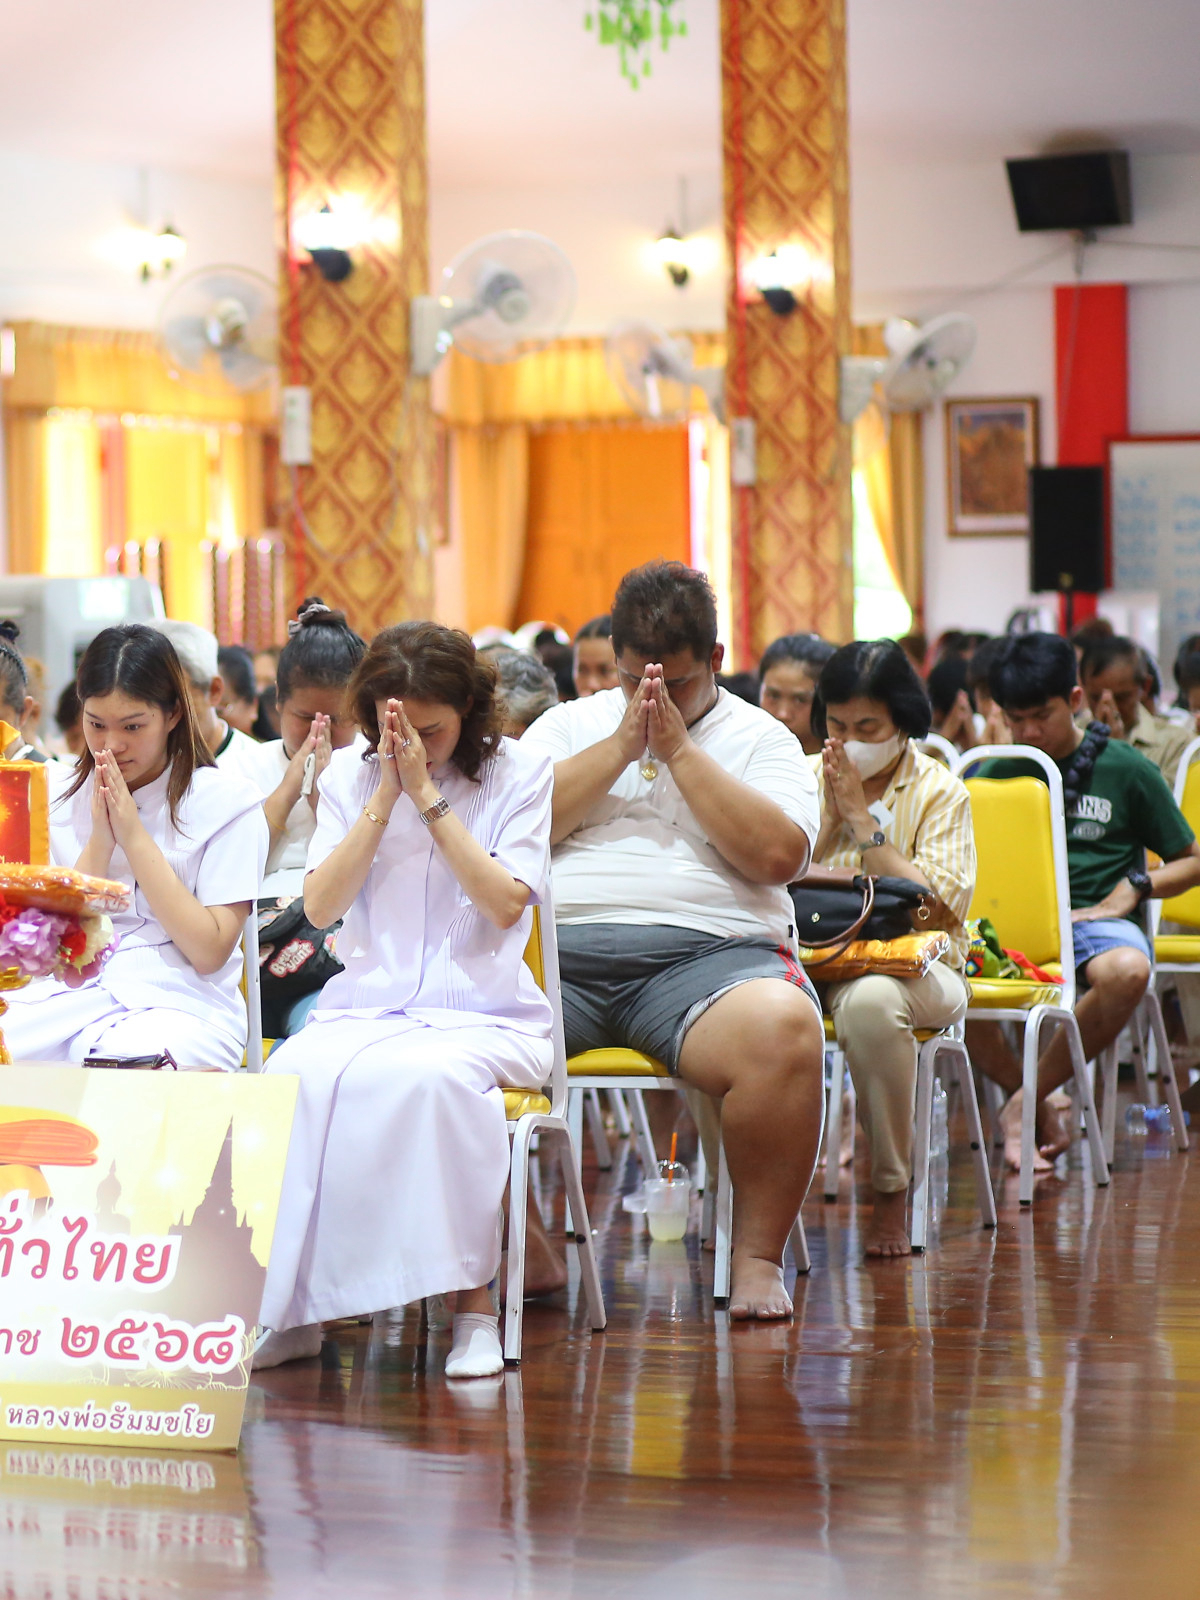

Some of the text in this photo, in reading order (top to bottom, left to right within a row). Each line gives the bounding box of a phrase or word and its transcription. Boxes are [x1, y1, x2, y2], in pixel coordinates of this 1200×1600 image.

[60, 1317, 237, 1365] ๒๕๖๘
[8, 1403, 216, 1434] หลวงพ่อธัมมชโย
